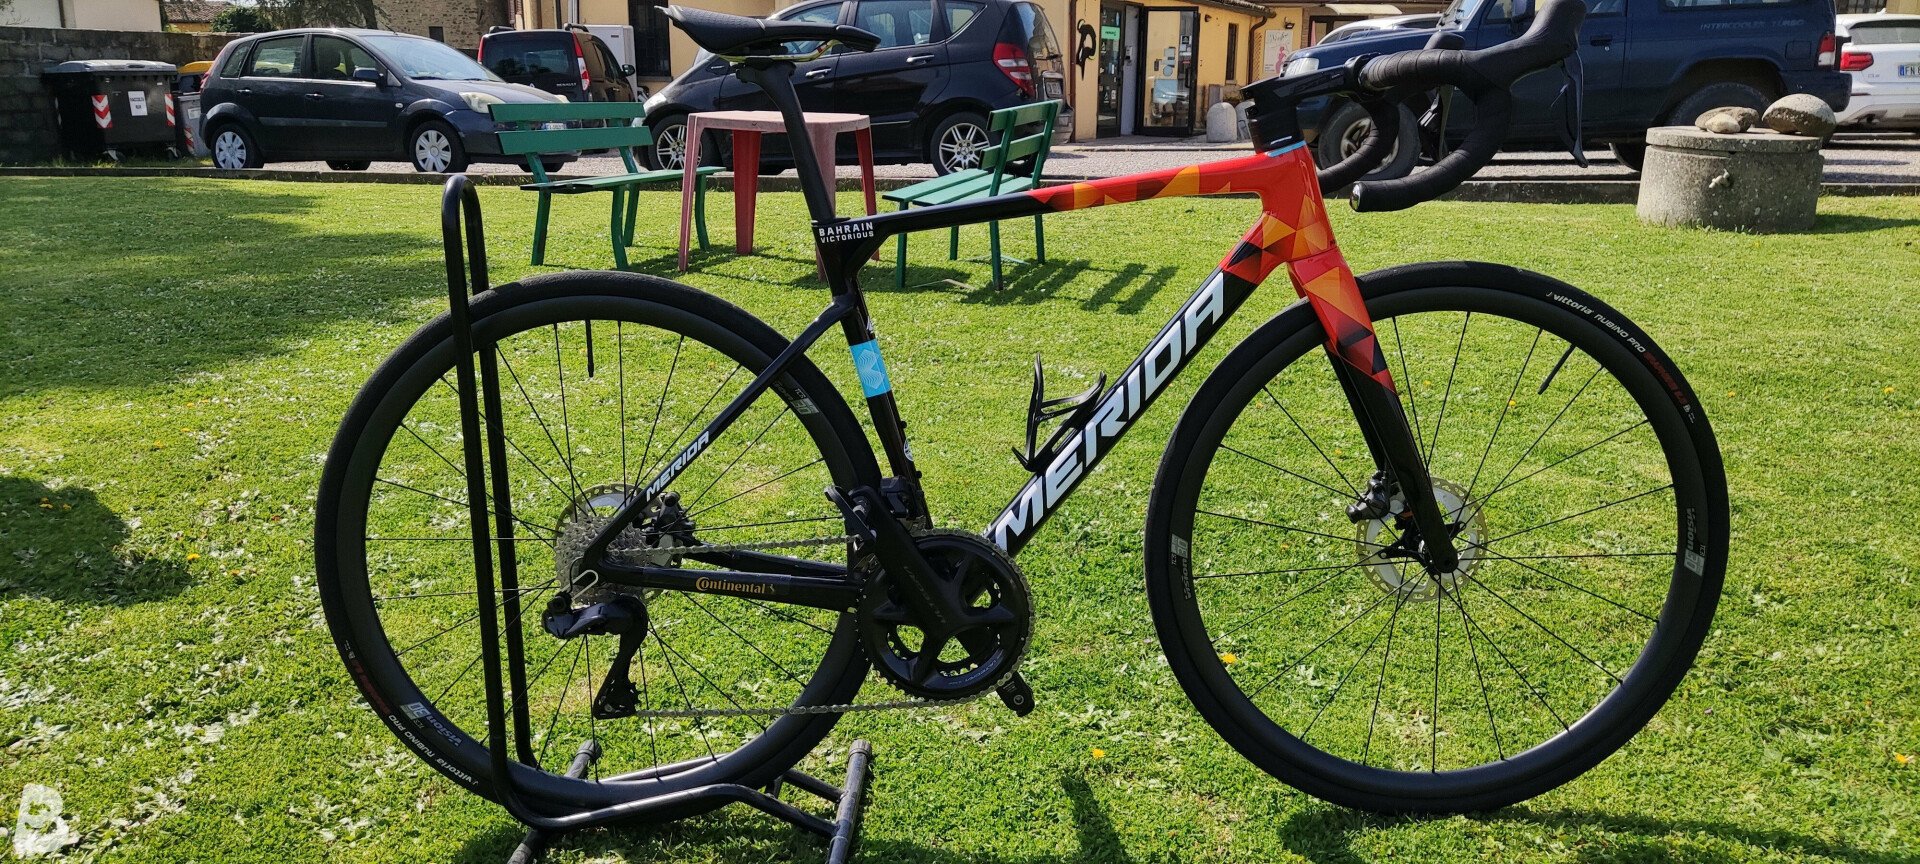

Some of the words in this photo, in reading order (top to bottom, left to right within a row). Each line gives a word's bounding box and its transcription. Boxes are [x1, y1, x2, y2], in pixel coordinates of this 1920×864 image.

[818, 221, 874, 237] BAHRAIN
[820, 231, 875, 244] VICTORIOUS
[1553, 294, 1594, 315] vittoria
[1593, 314, 1629, 338] RUBINO
[1626, 337, 1647, 353] PRO
[994, 272, 1224, 552] MERIDA
[646, 431, 710, 503] MERIDA
[695, 576, 766, 594] Continental
[388, 714, 406, 733] PRO
[404, 731, 435, 758] RUBINO
[435, 757, 473, 783] vittoria
